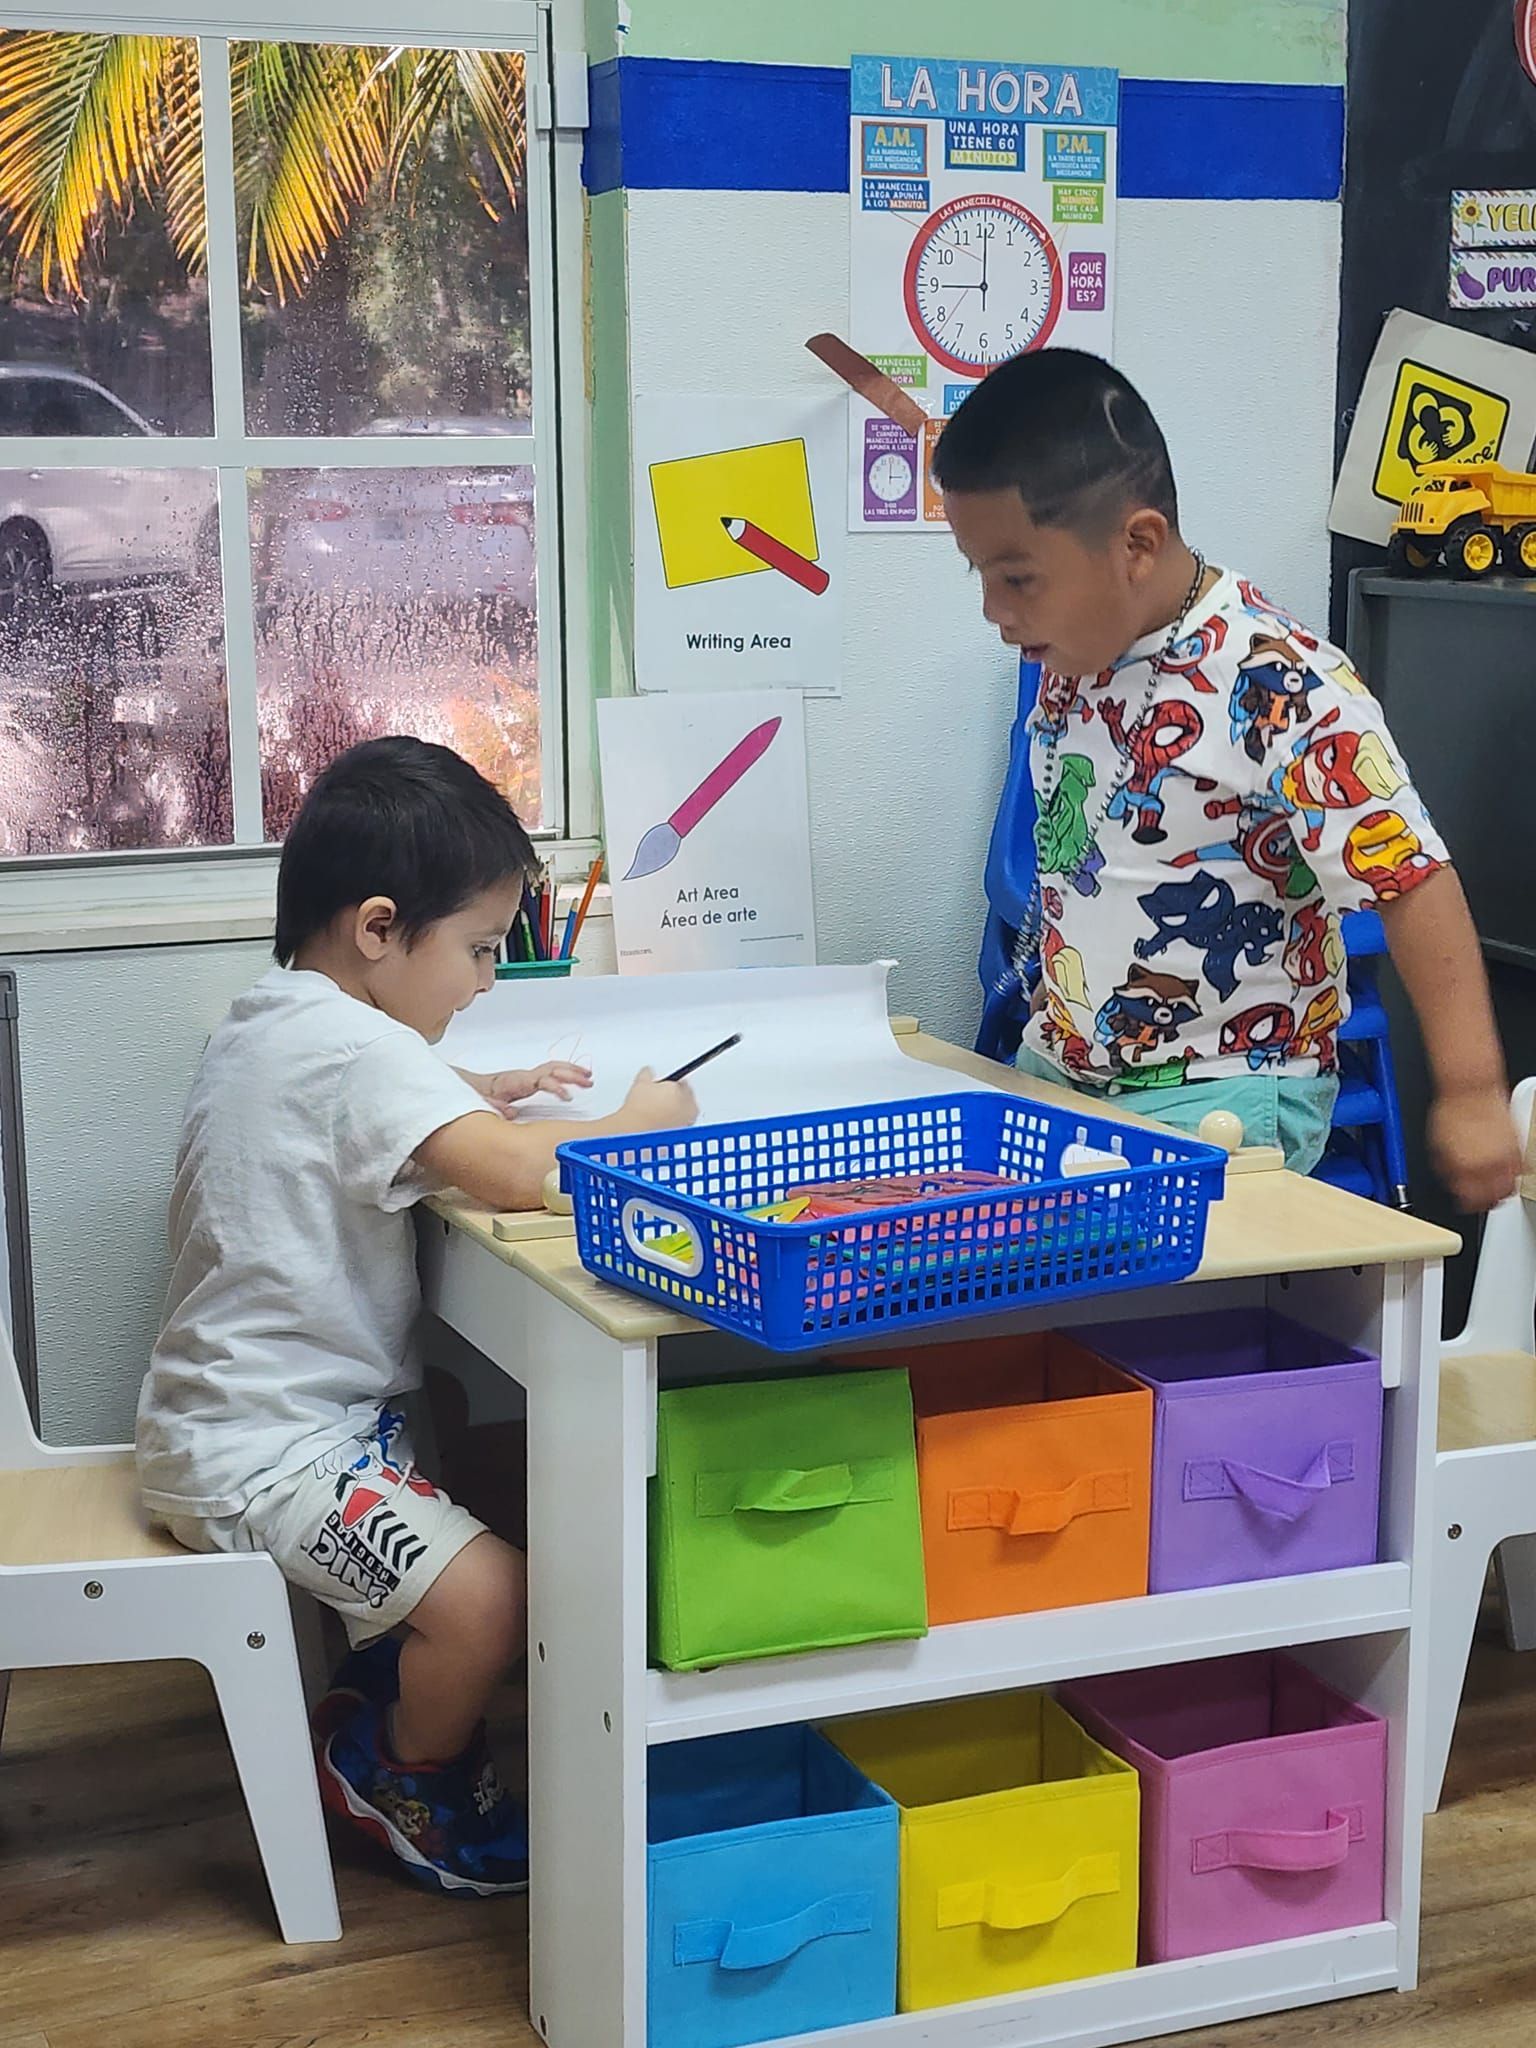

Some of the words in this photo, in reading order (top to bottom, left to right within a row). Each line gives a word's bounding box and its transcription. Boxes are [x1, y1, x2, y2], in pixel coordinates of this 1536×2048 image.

[882, 63, 937, 110] LA
[958, 68, 1084, 117] HORA
[874, 126, 915, 147] A.M.
[949, 121, 976, 134] UNA
[983, 122, 1019, 136] HORA
[953, 135, 992, 149] TIENE
[998, 138, 1015, 150] 60
[1056, 134, 1093, 154] P.M.
[951, 151, 1016, 164] MINUTOS
[864, 181, 875, 190] LA
[877, 182, 924, 192] MANECILLA
[864, 190, 890, 199] LARGA
[892, 191, 924, 200] APUNTA
[873, 200, 888, 208] LOS
[890, 200, 928, 210] MINUTOS
[938, 206, 954, 220] LAS
[953, 196, 1001, 212] MANECILLAS
[1486, 203, 1536, 232] YEL
[954, 230, 970, 246] 11
[976, 223, 995, 239] 12
[1006, 231, 1014, 246] 1
[937, 249, 954, 265] 10
[1024, 251, 1032, 267] 2
[930, 277, 939, 293] 9
[1030, 280, 1038, 296] 3
[1071, 276, 1103, 288] HORA
[1076, 290, 1097, 302] ES?
[937, 306, 946, 322] 8
[1020, 307, 1029, 322] 4
[956, 323, 964, 338] 7
[1005, 324, 1013, 340] 5
[979, 333, 988, 349] 6
[686, 633, 744, 652] Writing
[750, 633, 792, 649] Area
[676, 887, 698, 903] Art
[703, 886, 739, 901] Area
[660, 909, 698, 929] Área
[702, 910, 722, 924] de
[727, 907, 757, 923] arte
